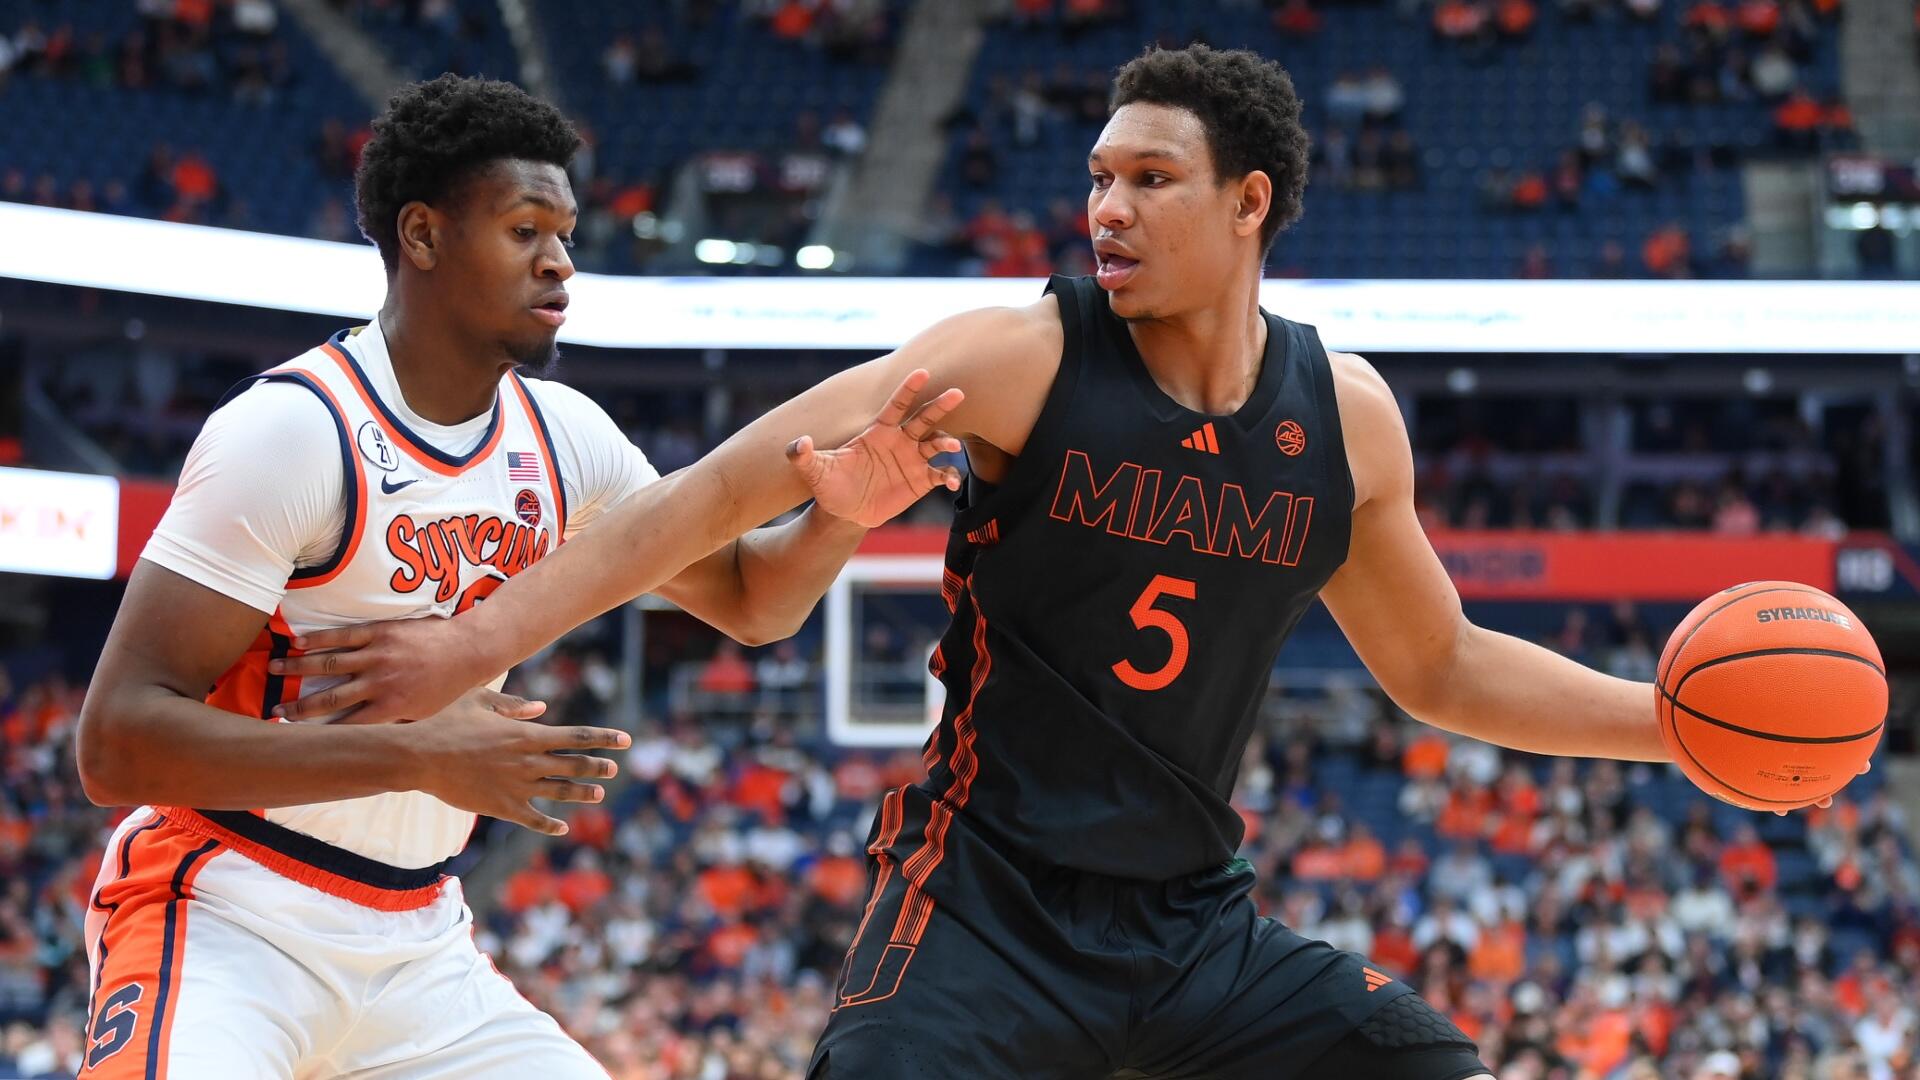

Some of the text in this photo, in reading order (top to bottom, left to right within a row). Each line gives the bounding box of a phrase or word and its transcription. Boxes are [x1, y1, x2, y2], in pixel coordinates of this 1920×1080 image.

[376, 443, 392, 464] 21
[1279, 431, 1303, 442] ACC
[1049, 449, 1314, 567] MIAMI
[1111, 574, 1197, 691] 5
[1756, 607, 1852, 631] SYRACUSE
[88, 982, 144, 1070] S
